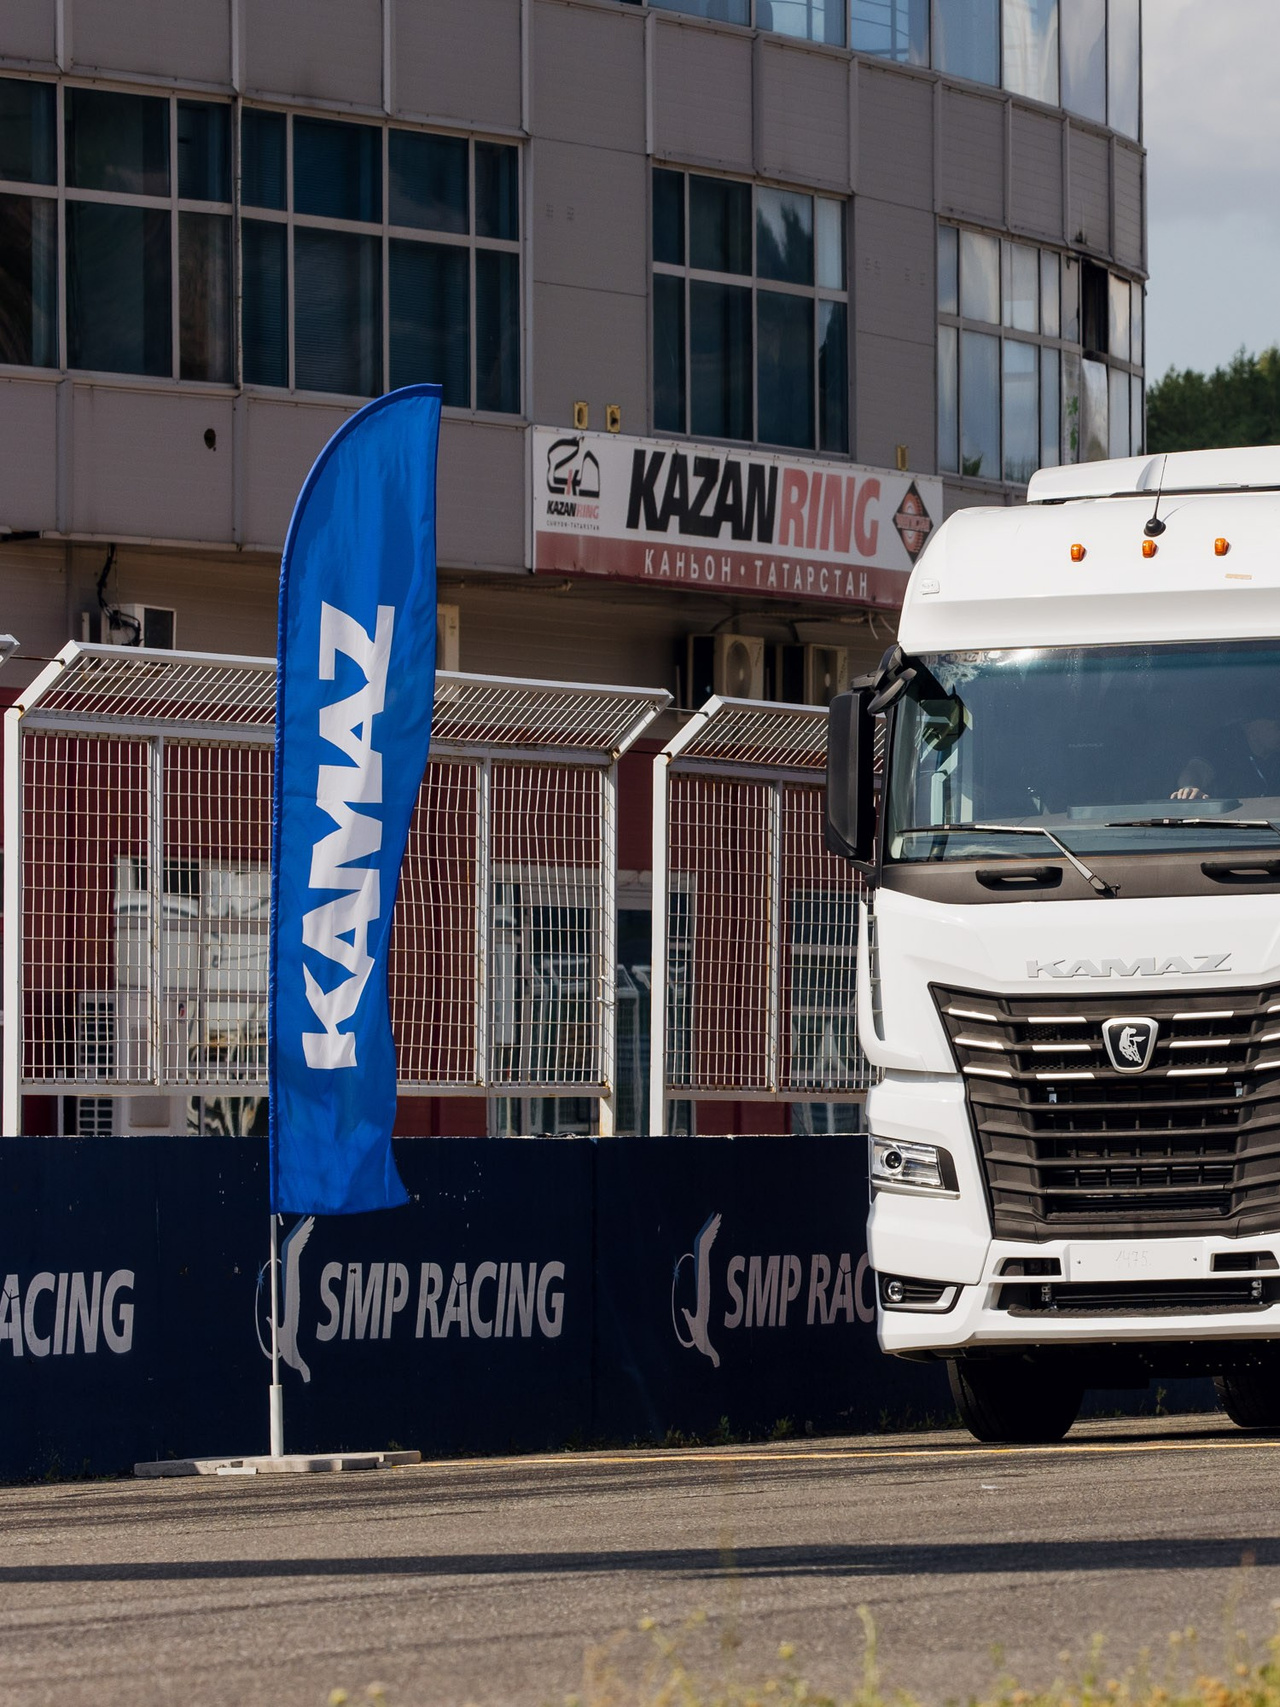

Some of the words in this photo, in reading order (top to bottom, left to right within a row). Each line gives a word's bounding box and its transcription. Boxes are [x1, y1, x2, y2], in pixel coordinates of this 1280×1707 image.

[644, 549, 731, 583] КАНЬОН
[754, 559, 868, 598] ТАТАРСТАН
[302, 600, 395, 1069] KAMAZ
[1026, 952, 1232, 979] KAMAZ
[316, 1261, 410, 1342] SMP
[415, 1260, 566, 1339] RACING
[724, 1255, 802, 1329] SMP
